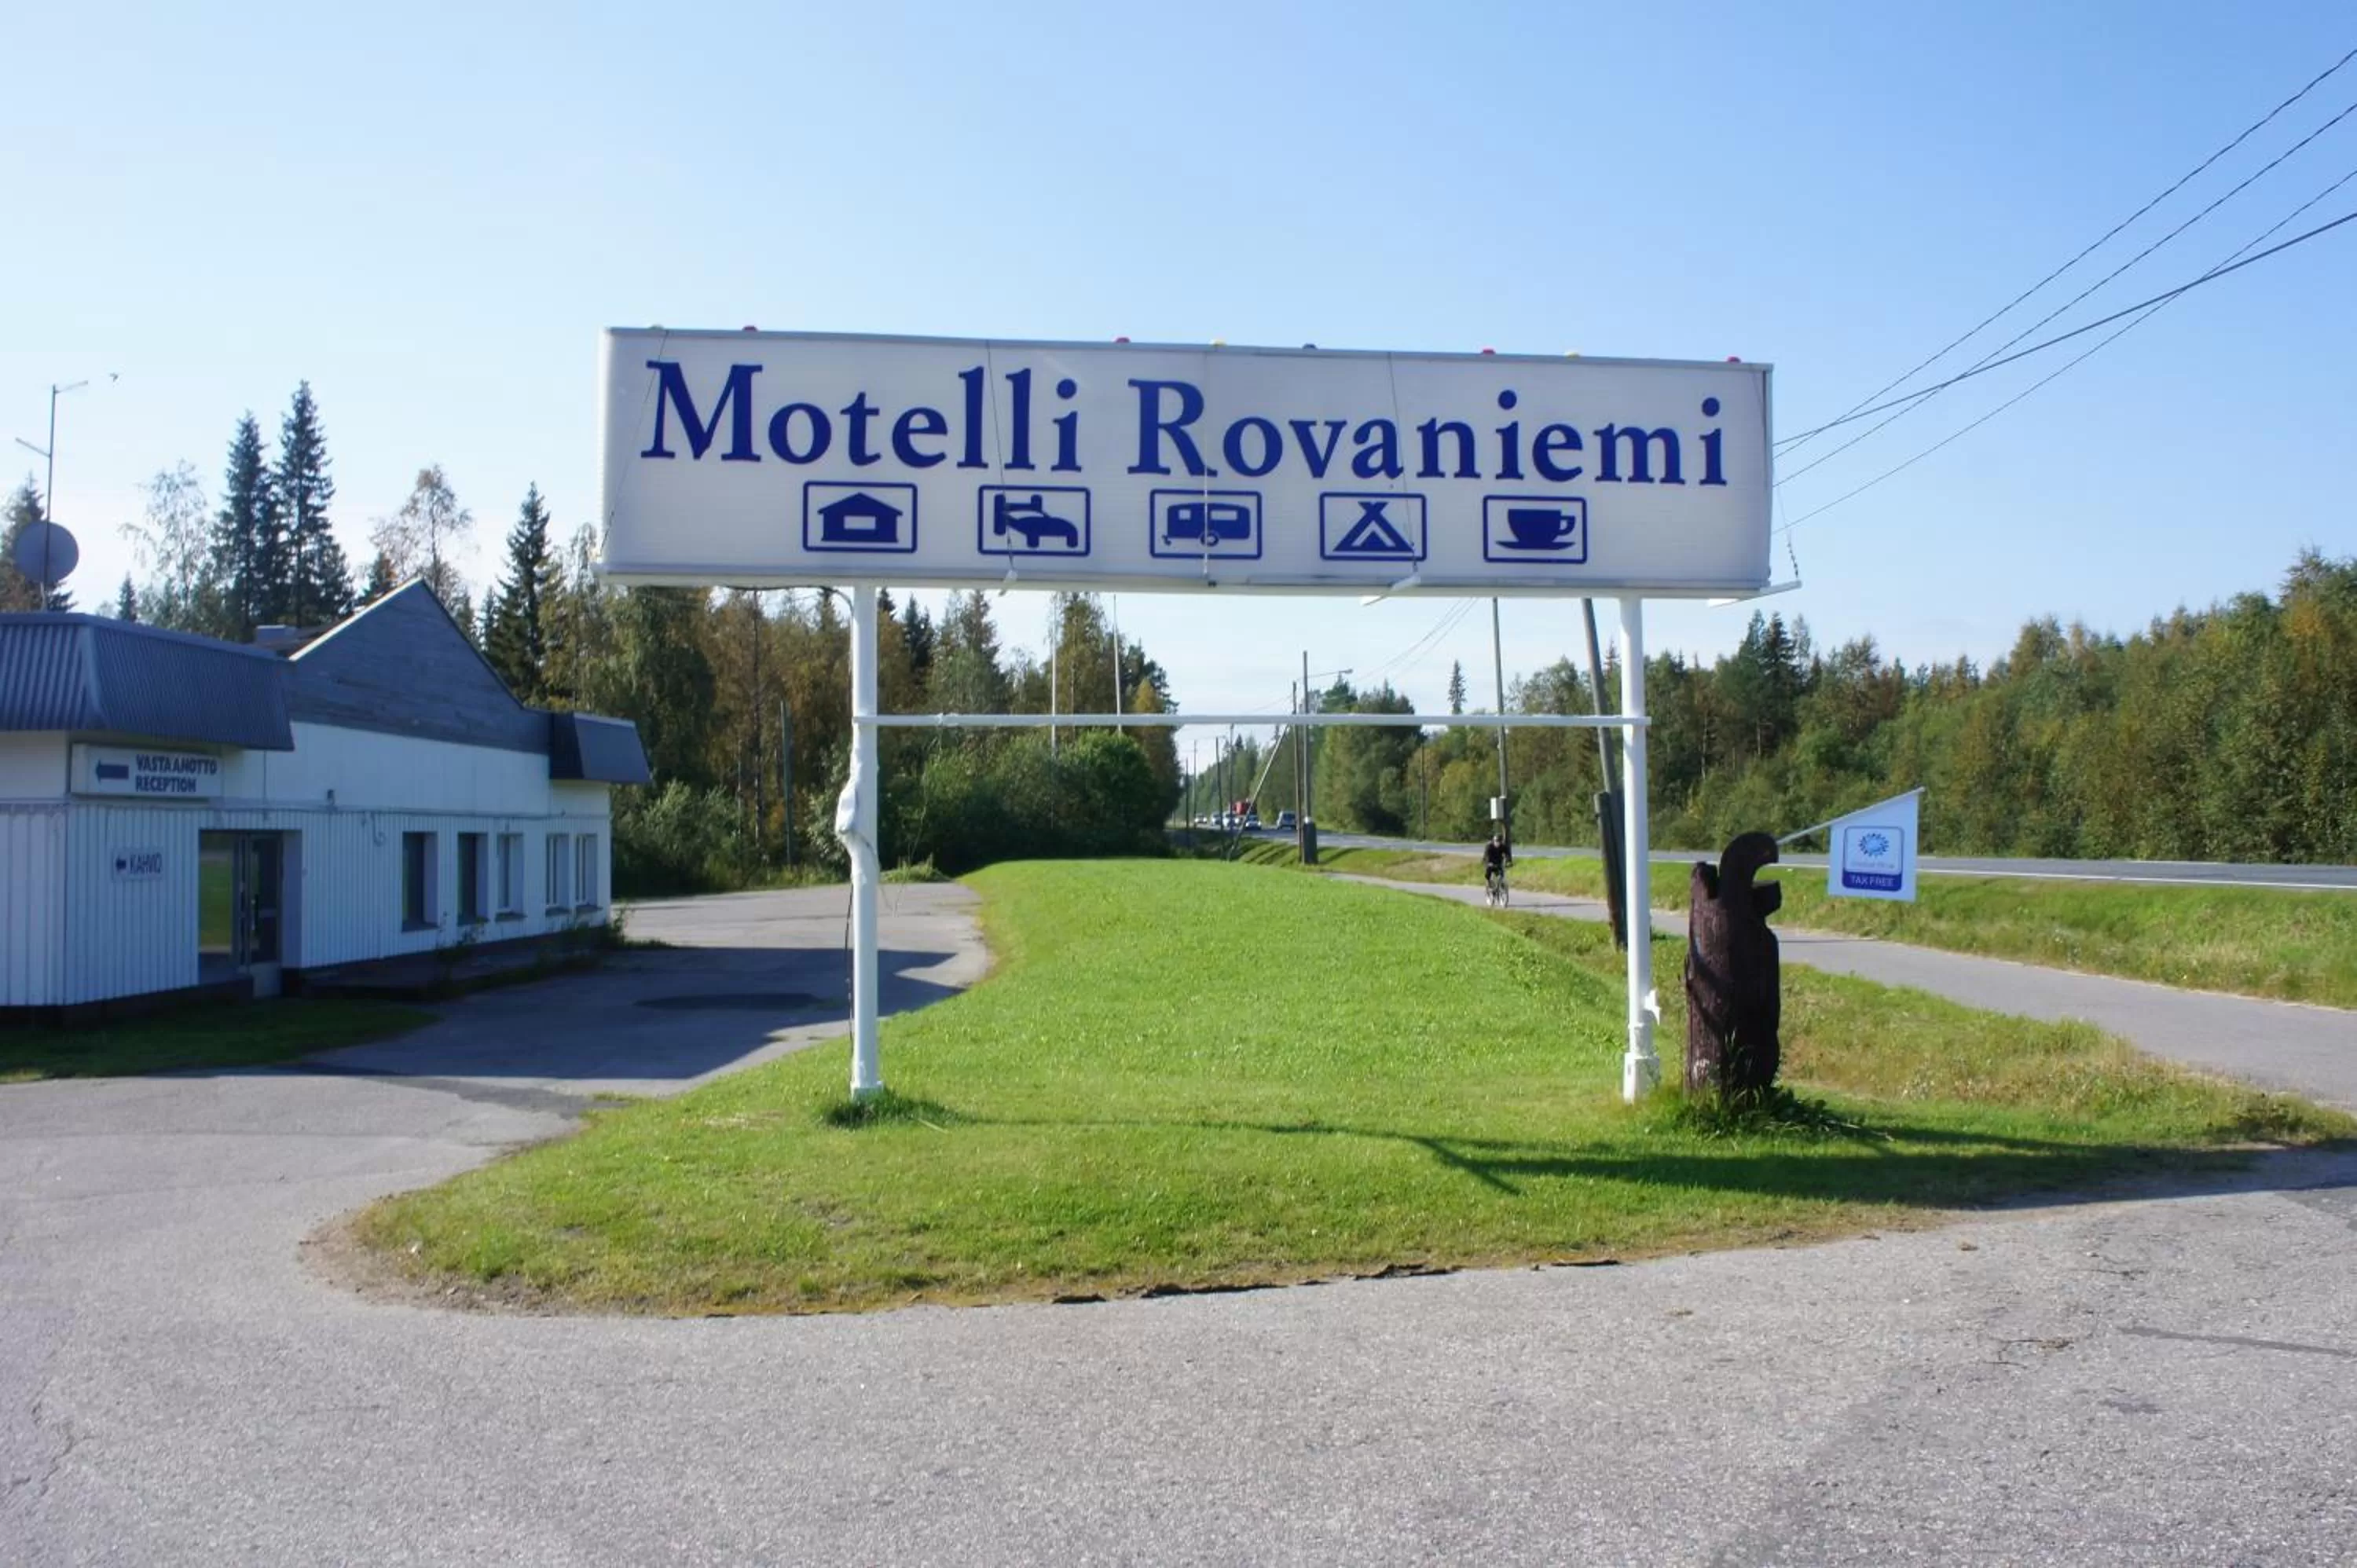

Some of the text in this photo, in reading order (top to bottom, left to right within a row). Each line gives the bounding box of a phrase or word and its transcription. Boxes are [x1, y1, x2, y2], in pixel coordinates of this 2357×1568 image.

[640, 360, 1728, 485] Motelli Rovaniemi
[136, 754, 218, 775] VASTAANOTTO
[136, 775, 196, 793] RECEPTION
[1851, 874, 1895, 887] TAX FREE
